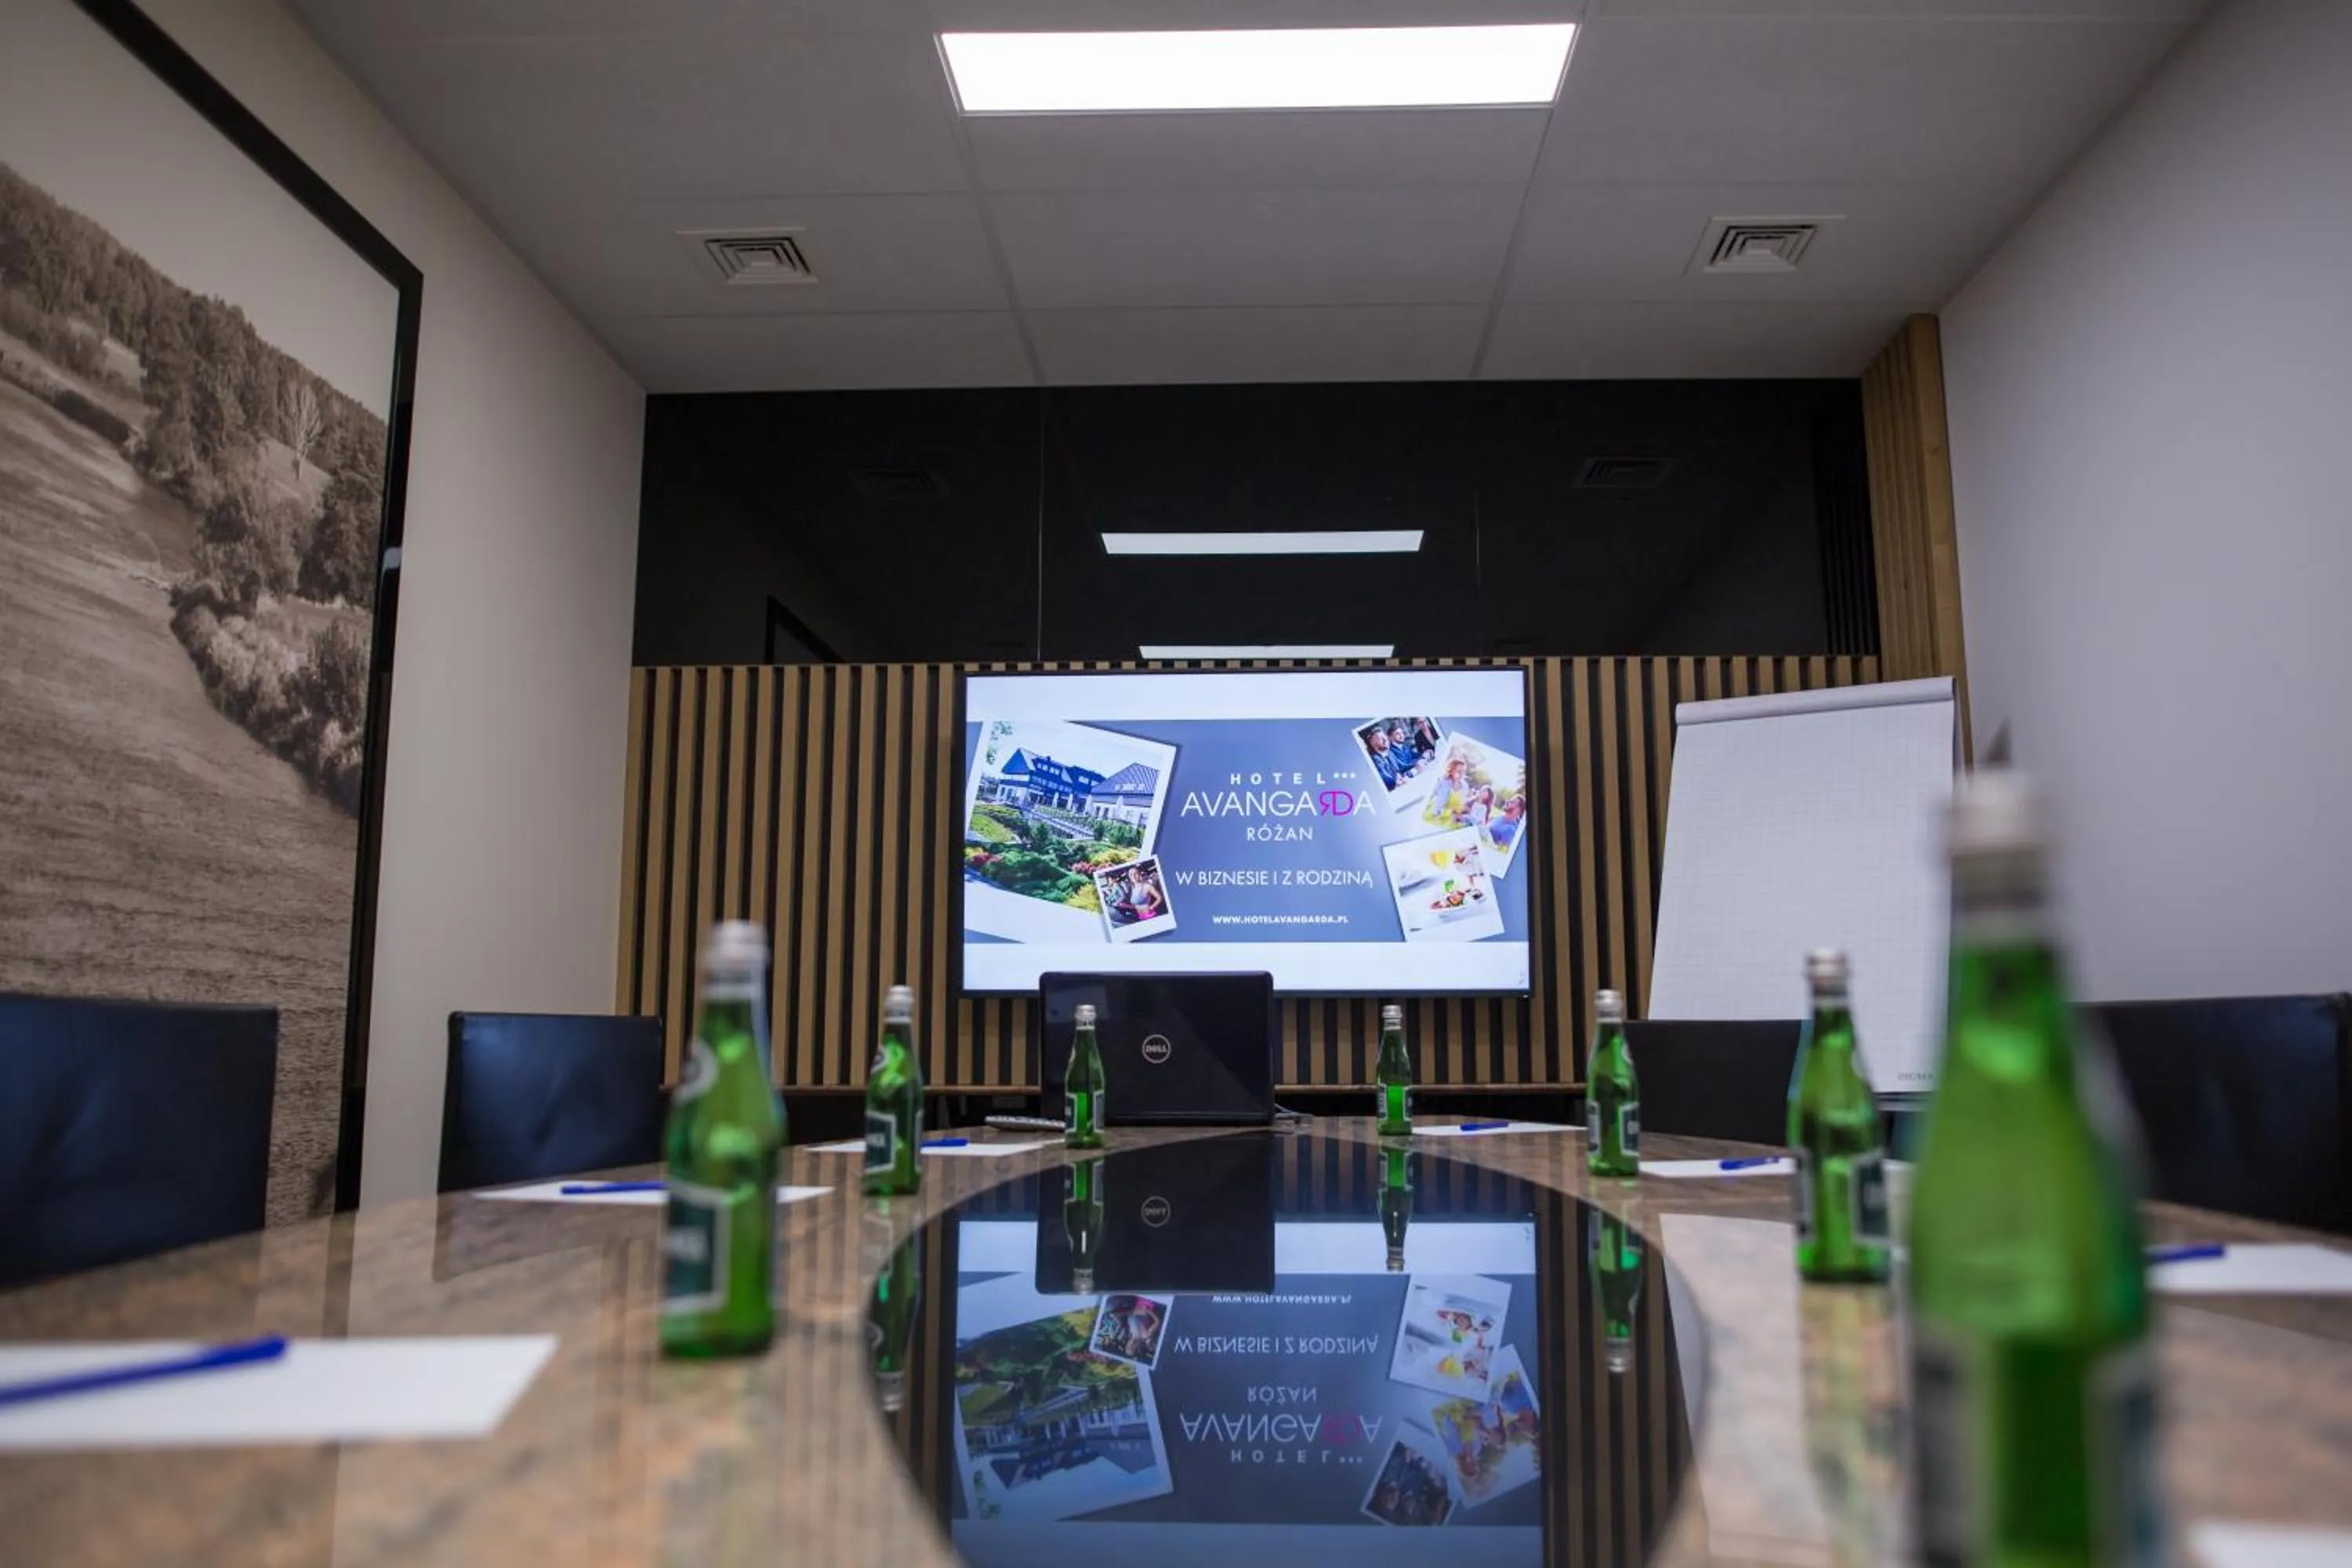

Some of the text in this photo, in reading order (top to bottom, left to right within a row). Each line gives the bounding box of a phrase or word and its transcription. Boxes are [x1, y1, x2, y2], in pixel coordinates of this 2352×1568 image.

[1230, 772, 1327, 785] HOTEL
[1180, 790, 1376, 817] AVANGARDA
[1247, 823, 1313, 841] RÓŻAN
[1175, 870, 1374, 888] W BIZNESIE I Z RODZINĄ
[1213, 915, 1348, 924] WWW.HOTELAVANGARDA.PL
